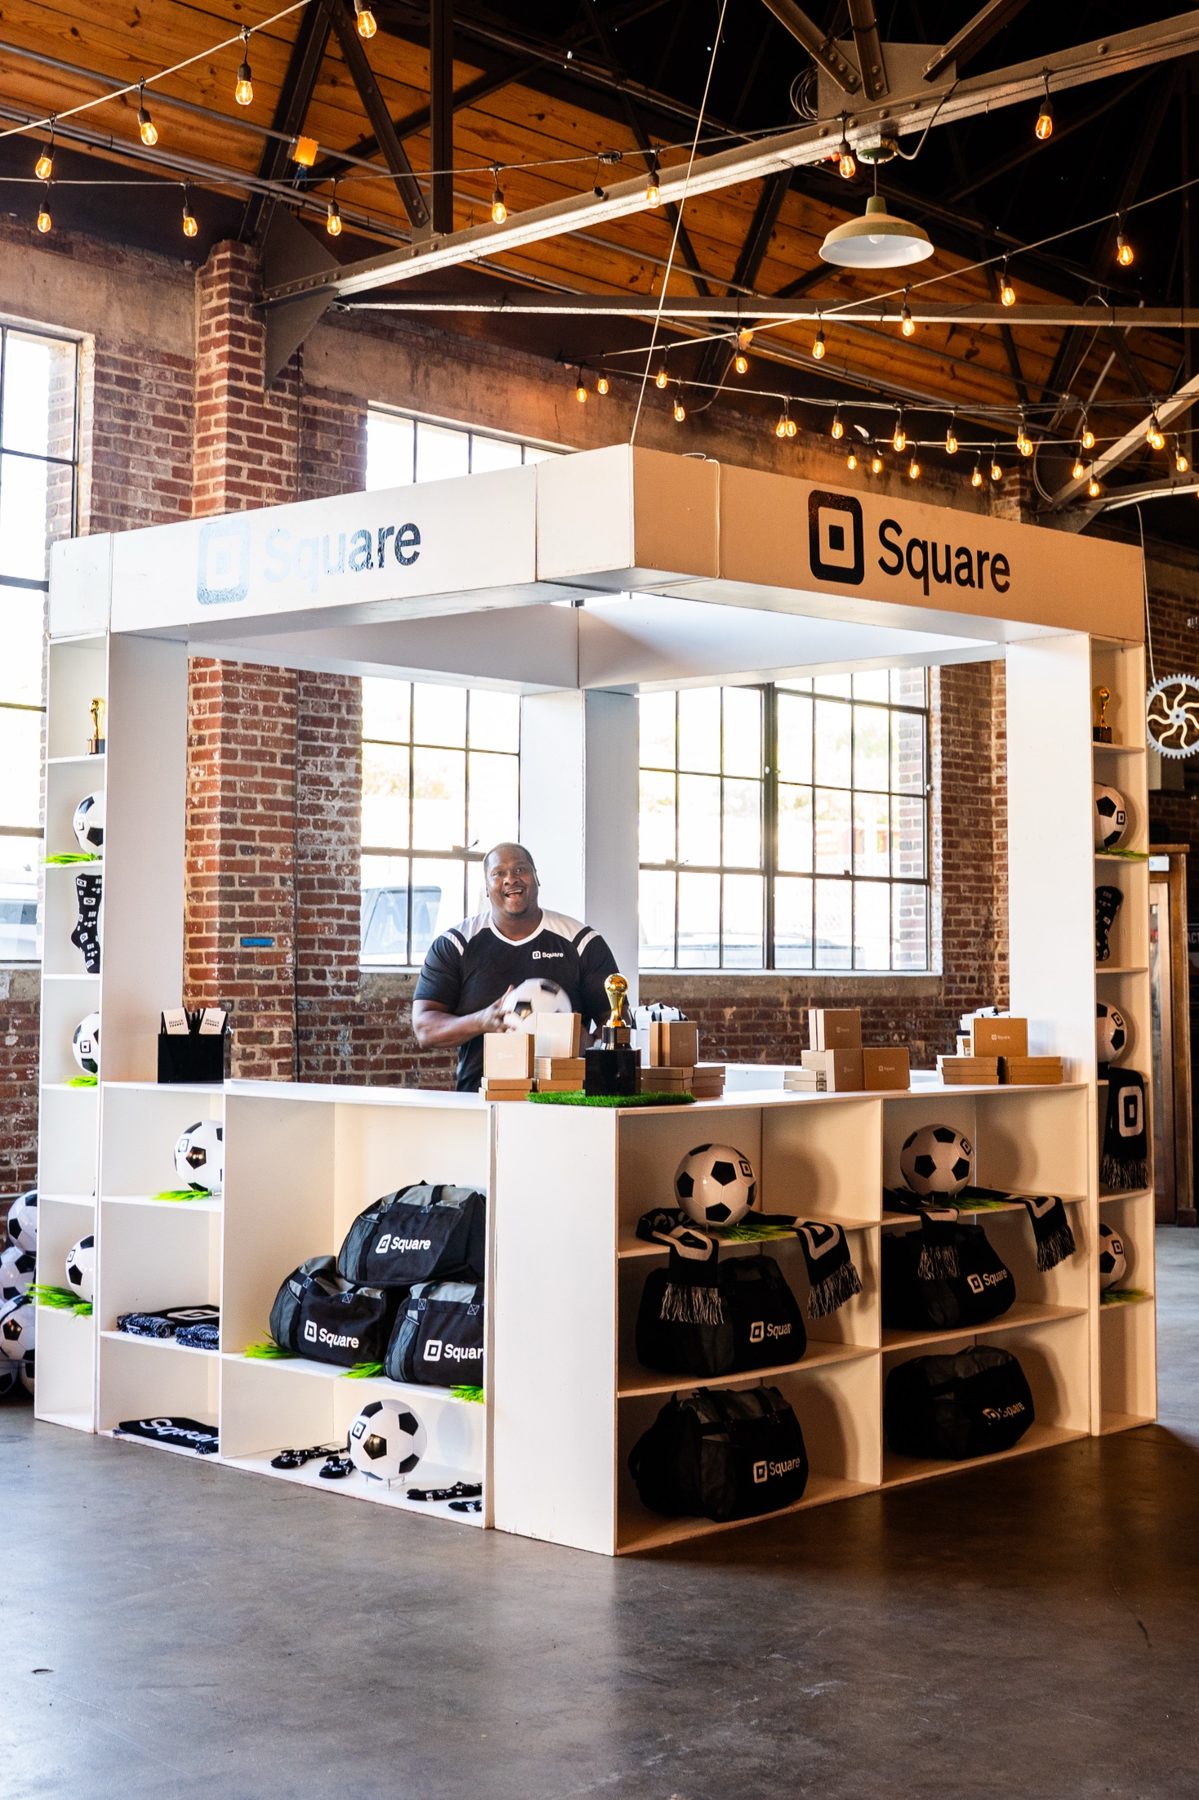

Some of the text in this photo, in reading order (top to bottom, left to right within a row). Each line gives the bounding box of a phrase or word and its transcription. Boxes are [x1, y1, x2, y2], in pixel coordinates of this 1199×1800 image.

[264, 522, 421, 593] Square
[878, 518, 1011, 597] Square
[390, 1236, 431, 1251] Square
[984, 1268, 1009, 1288] Square
[318, 1329, 360, 1349] Square
[766, 1322, 793, 1340] Squar
[443, 1343, 484, 1363] Squar
[768, 1457, 802, 1479] Square
